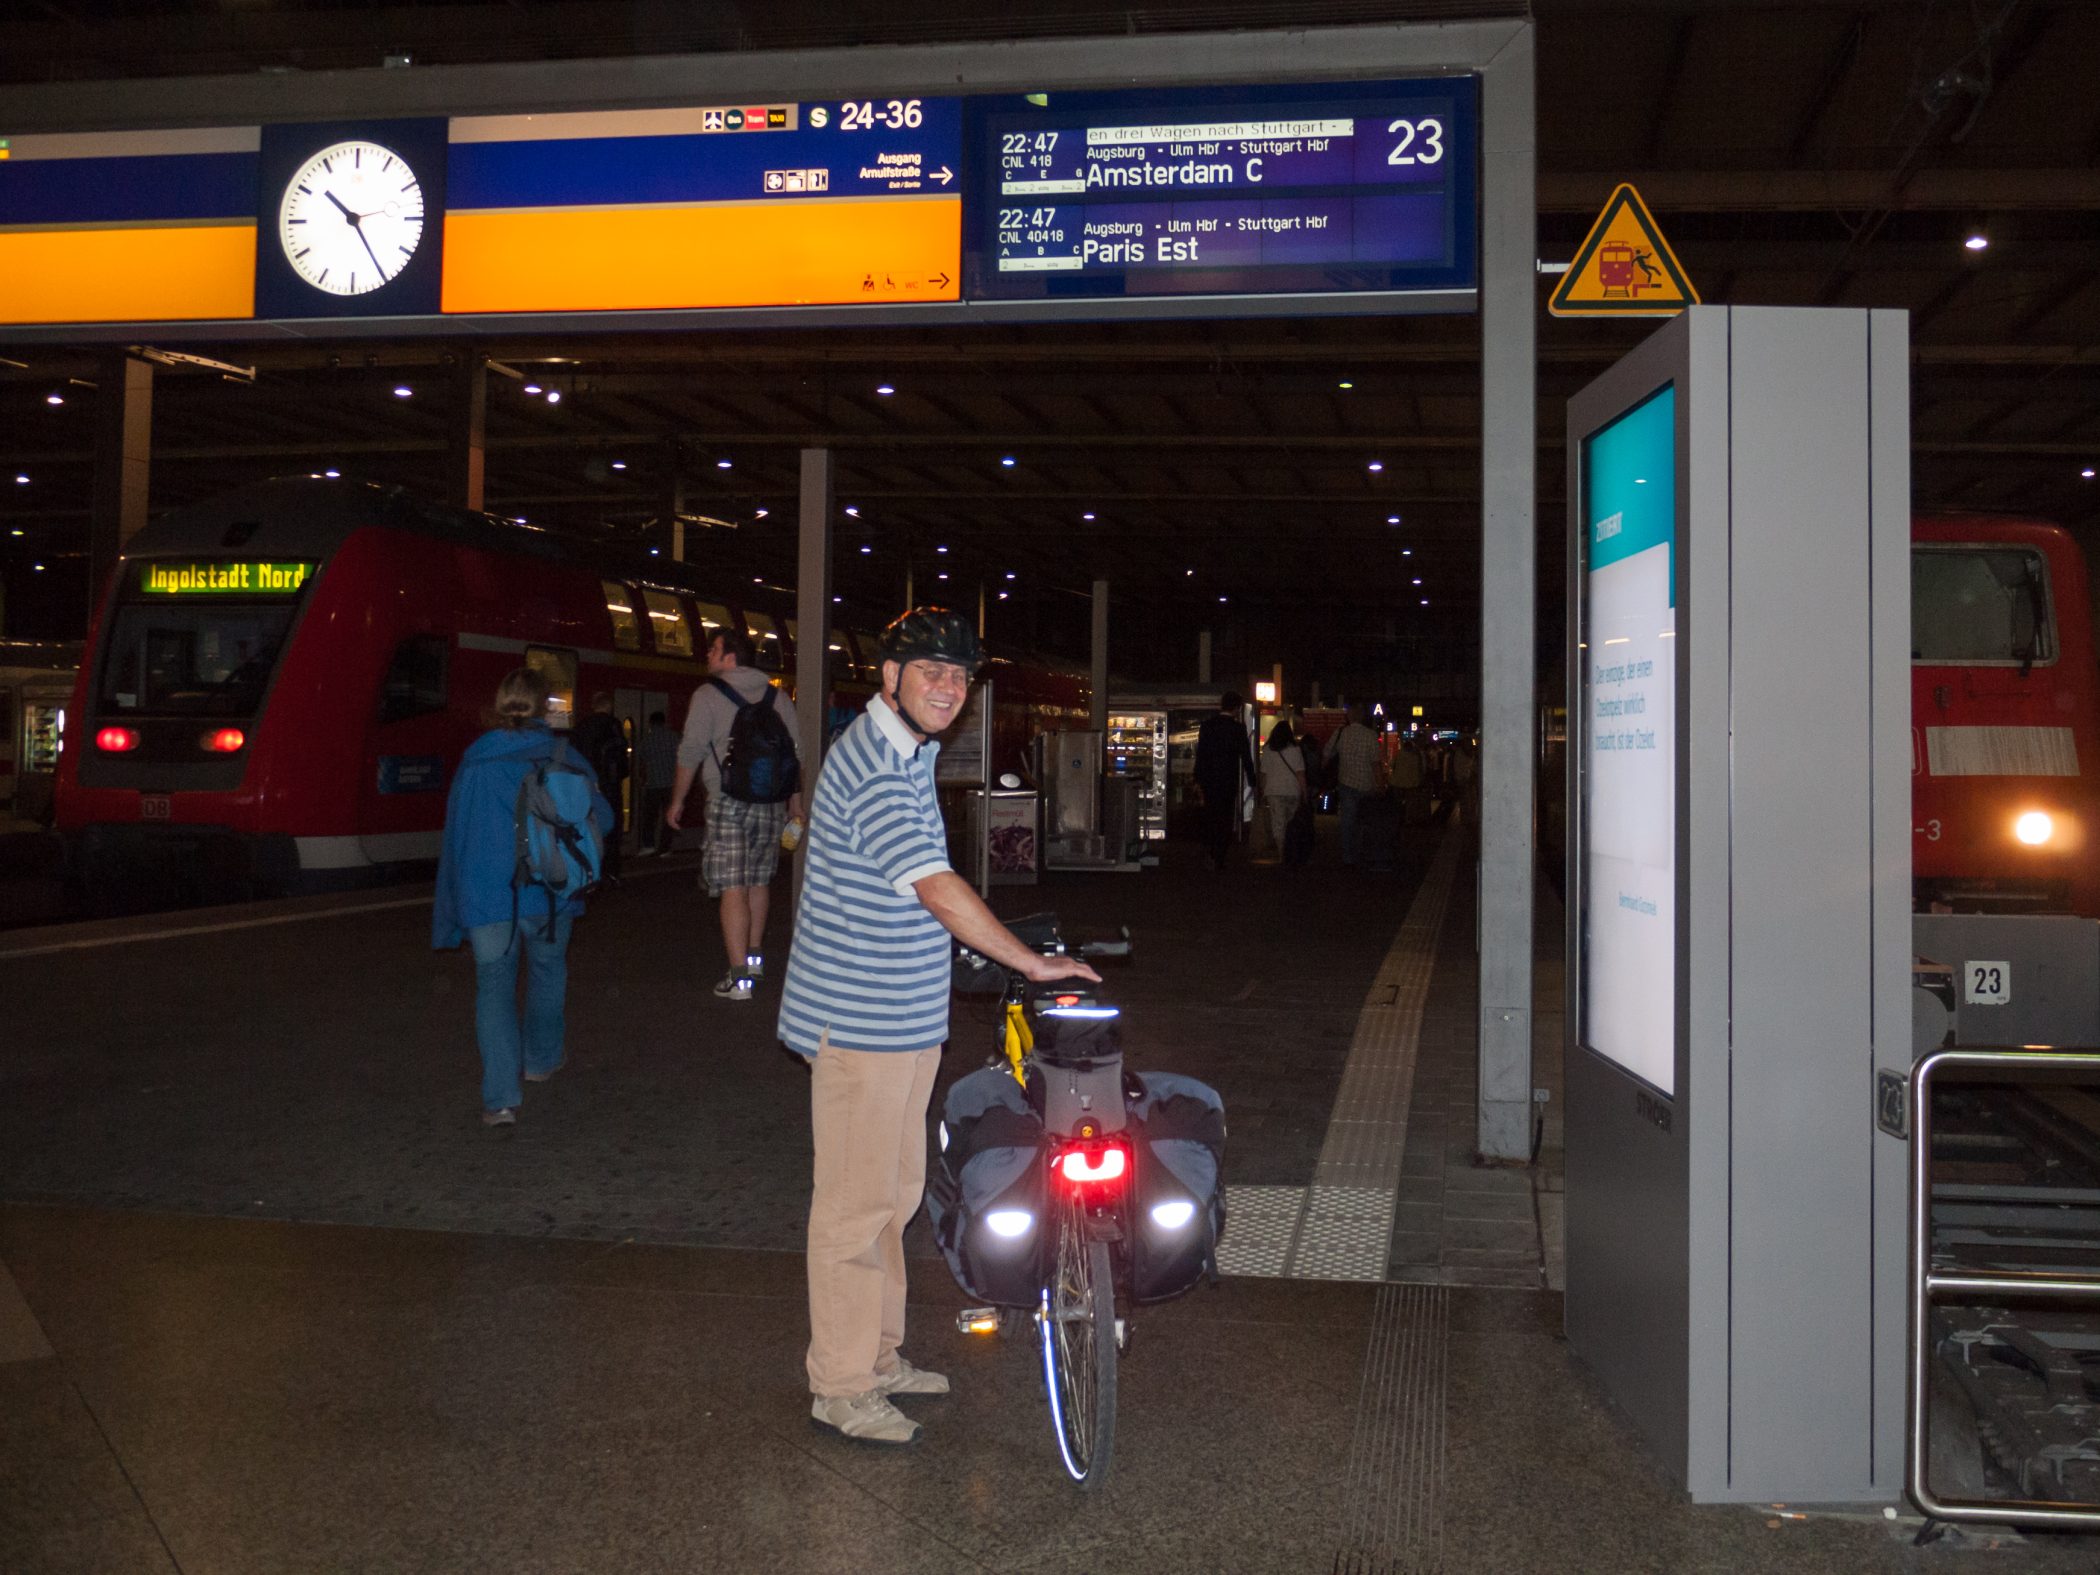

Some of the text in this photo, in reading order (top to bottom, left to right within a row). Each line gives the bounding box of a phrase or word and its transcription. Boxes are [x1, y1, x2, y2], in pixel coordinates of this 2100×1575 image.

[840, 100, 923, 131] 24-36
[1089, 130, 1108, 142] en
[1114, 128, 1144, 140] drei
[1150, 126, 1201, 141] Wagen
[1208, 123, 1244, 137] nach
[1251, 120, 1324, 136] Stuttgart
[1387, 118, 1444, 165] 23
[1001, 132, 1059, 154] 22:47
[1086, 146, 1146, 162] Augsburg
[1170, 143, 1194, 156] Ulm
[1198, 142, 1220, 156] Hbf
[1240, 140, 1303, 156] Stuttgart
[1307, 139, 1330, 152] Hbf
[877, 152, 922, 167] Ausgang
[1002, 155, 1052, 169] CNL 418
[1040, 169, 1047, 179] E
[1086, 158, 1263, 187] Amsterdam C
[998, 207, 1056, 230] 22:47
[1083, 222, 1143, 238] Augsburg
[1168, 220, 1191, 233] Ulm
[1196, 219, 1218, 232] Hbf
[1238, 216, 1301, 232] Stuttgart
[1306, 215, 1328, 229] Hbf
[999, 230, 1064, 244] CNL 40418
[1002, 247, 1010, 257] A
[1083, 236, 1198, 264] Paris Est
[151, 563, 305, 594] Ingolstadt Nord
[1373, 703, 1384, 715] A
[145, 801, 168, 816] DB
[1974, 967, 2001, 994] 23
